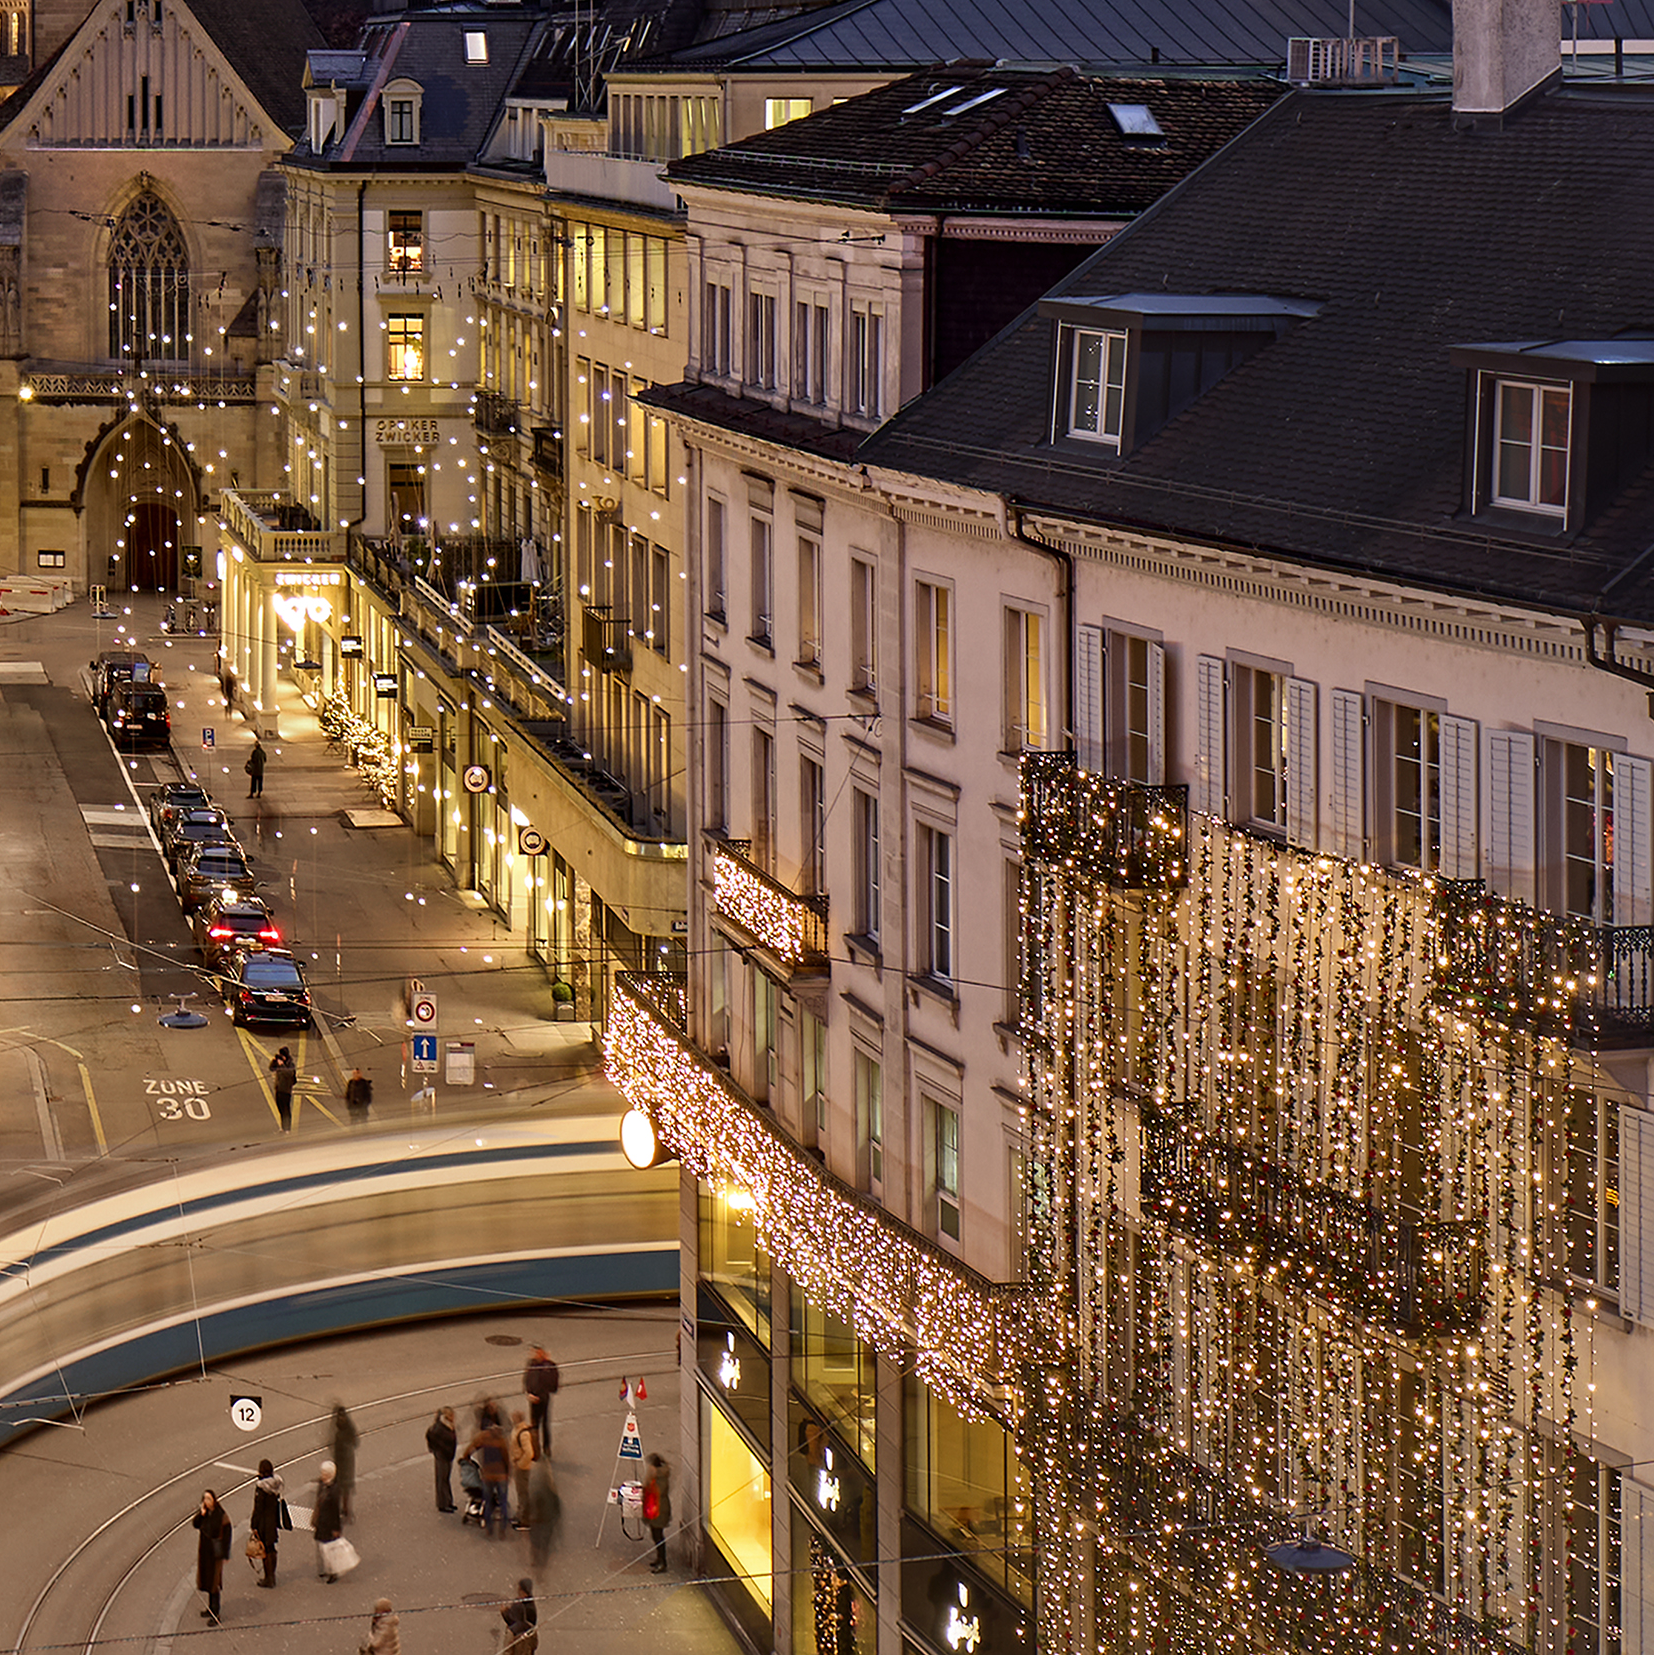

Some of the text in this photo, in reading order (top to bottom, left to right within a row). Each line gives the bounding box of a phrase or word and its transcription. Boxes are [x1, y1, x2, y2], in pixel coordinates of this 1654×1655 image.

[375, 431, 441, 442] ZWICKER
[276, 573, 341, 586] ZWICKER
[156, 1097, 212, 1121] 30
